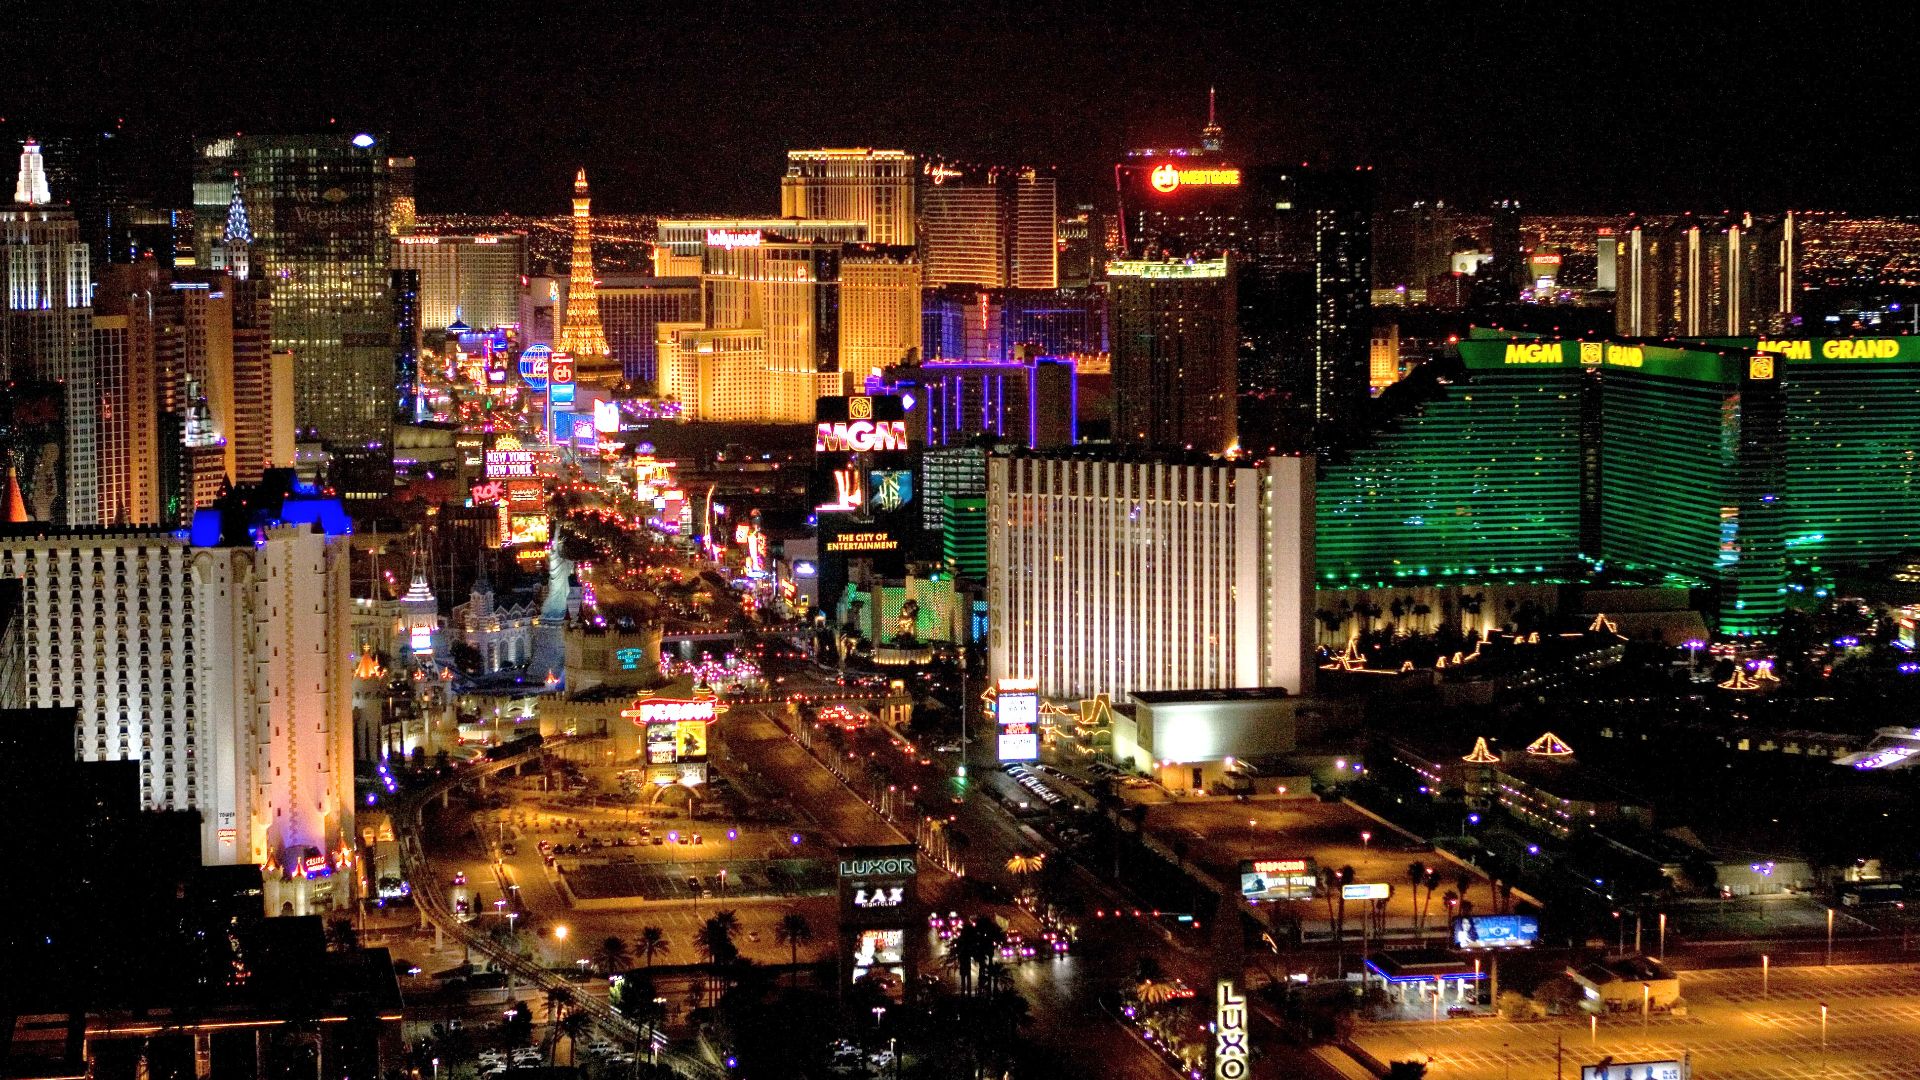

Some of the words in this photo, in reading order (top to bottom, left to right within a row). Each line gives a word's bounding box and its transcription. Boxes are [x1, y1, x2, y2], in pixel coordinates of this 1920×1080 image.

[707, 229, 760, 250] hollywood
[1504, 343, 1563, 364] MGM
[1608, 345, 1643, 367] GRAND
[1757, 340, 1812, 359] MGM
[1823, 339, 1899, 359] GRAND
[816, 421, 907, 452] MGM
[487, 451, 506, 462] NEW
[508, 451, 532, 462] YORK
[487, 464, 506, 475] NEW
[508, 463, 532, 474] YORK
[877, 533, 888, 541] OF
[827, 541, 898, 551] ENTERTAINMENT
[306, 856, 325, 867] CASINO
[841, 859, 916, 876] LUXOR
[855, 887, 904, 904] LAX
